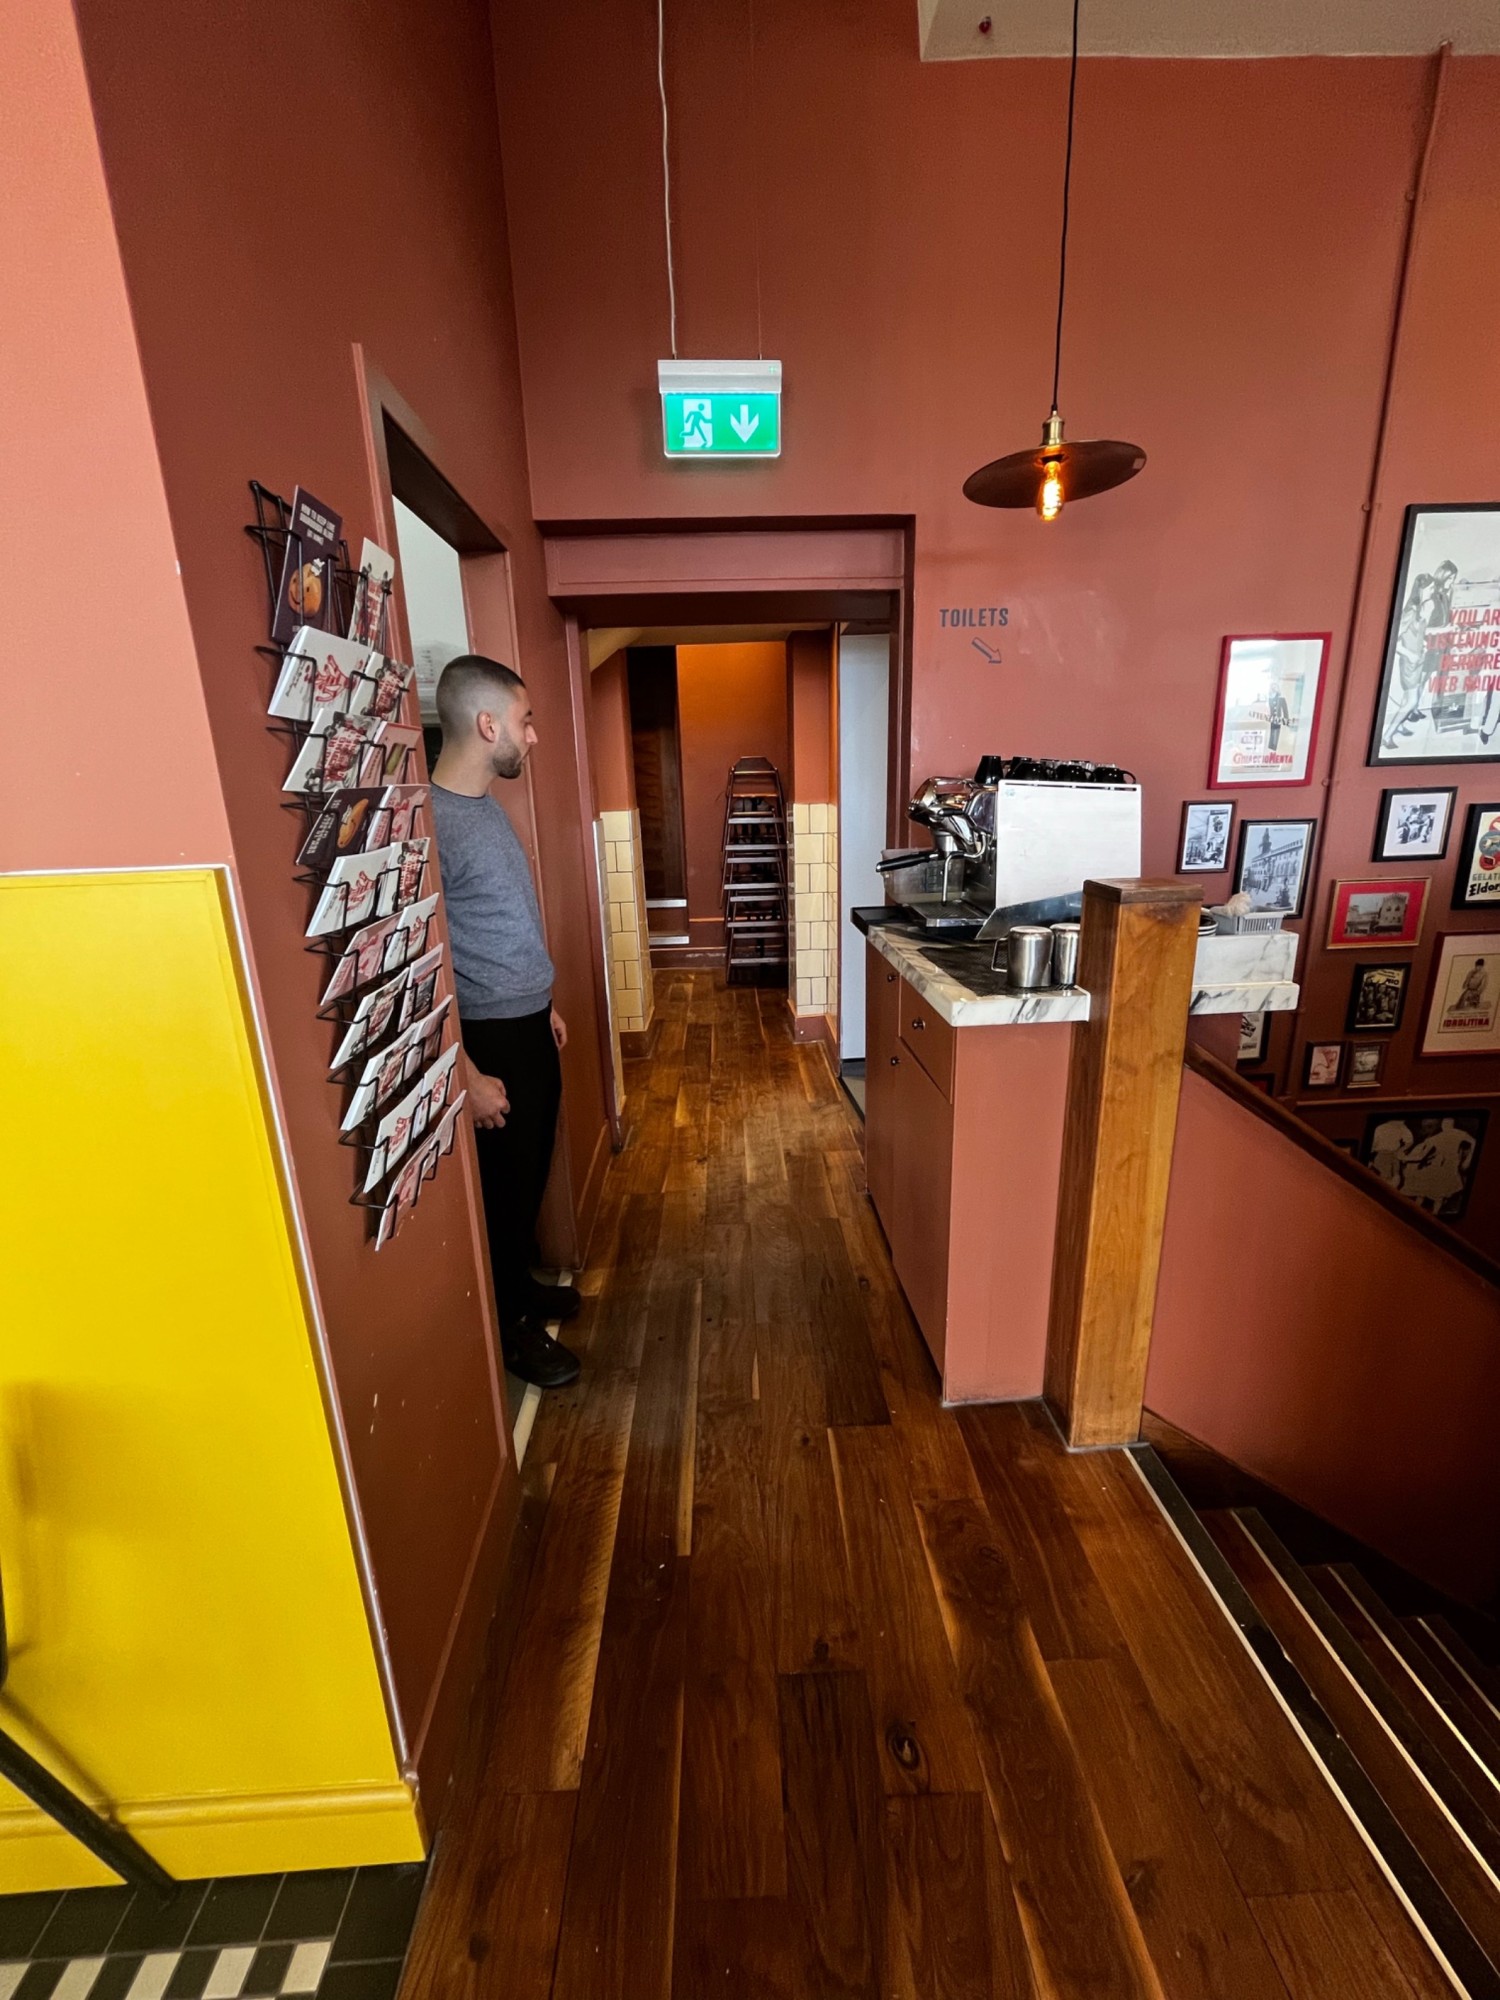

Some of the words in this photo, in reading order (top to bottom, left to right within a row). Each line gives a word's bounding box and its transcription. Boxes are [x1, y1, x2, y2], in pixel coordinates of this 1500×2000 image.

[939, 607, 1009, 627] TOILETS
[1449, 608, 1478, 627] YOU
[1425, 630, 1500, 650] LISTENING
[1428, 675, 1458, 693] WEB
